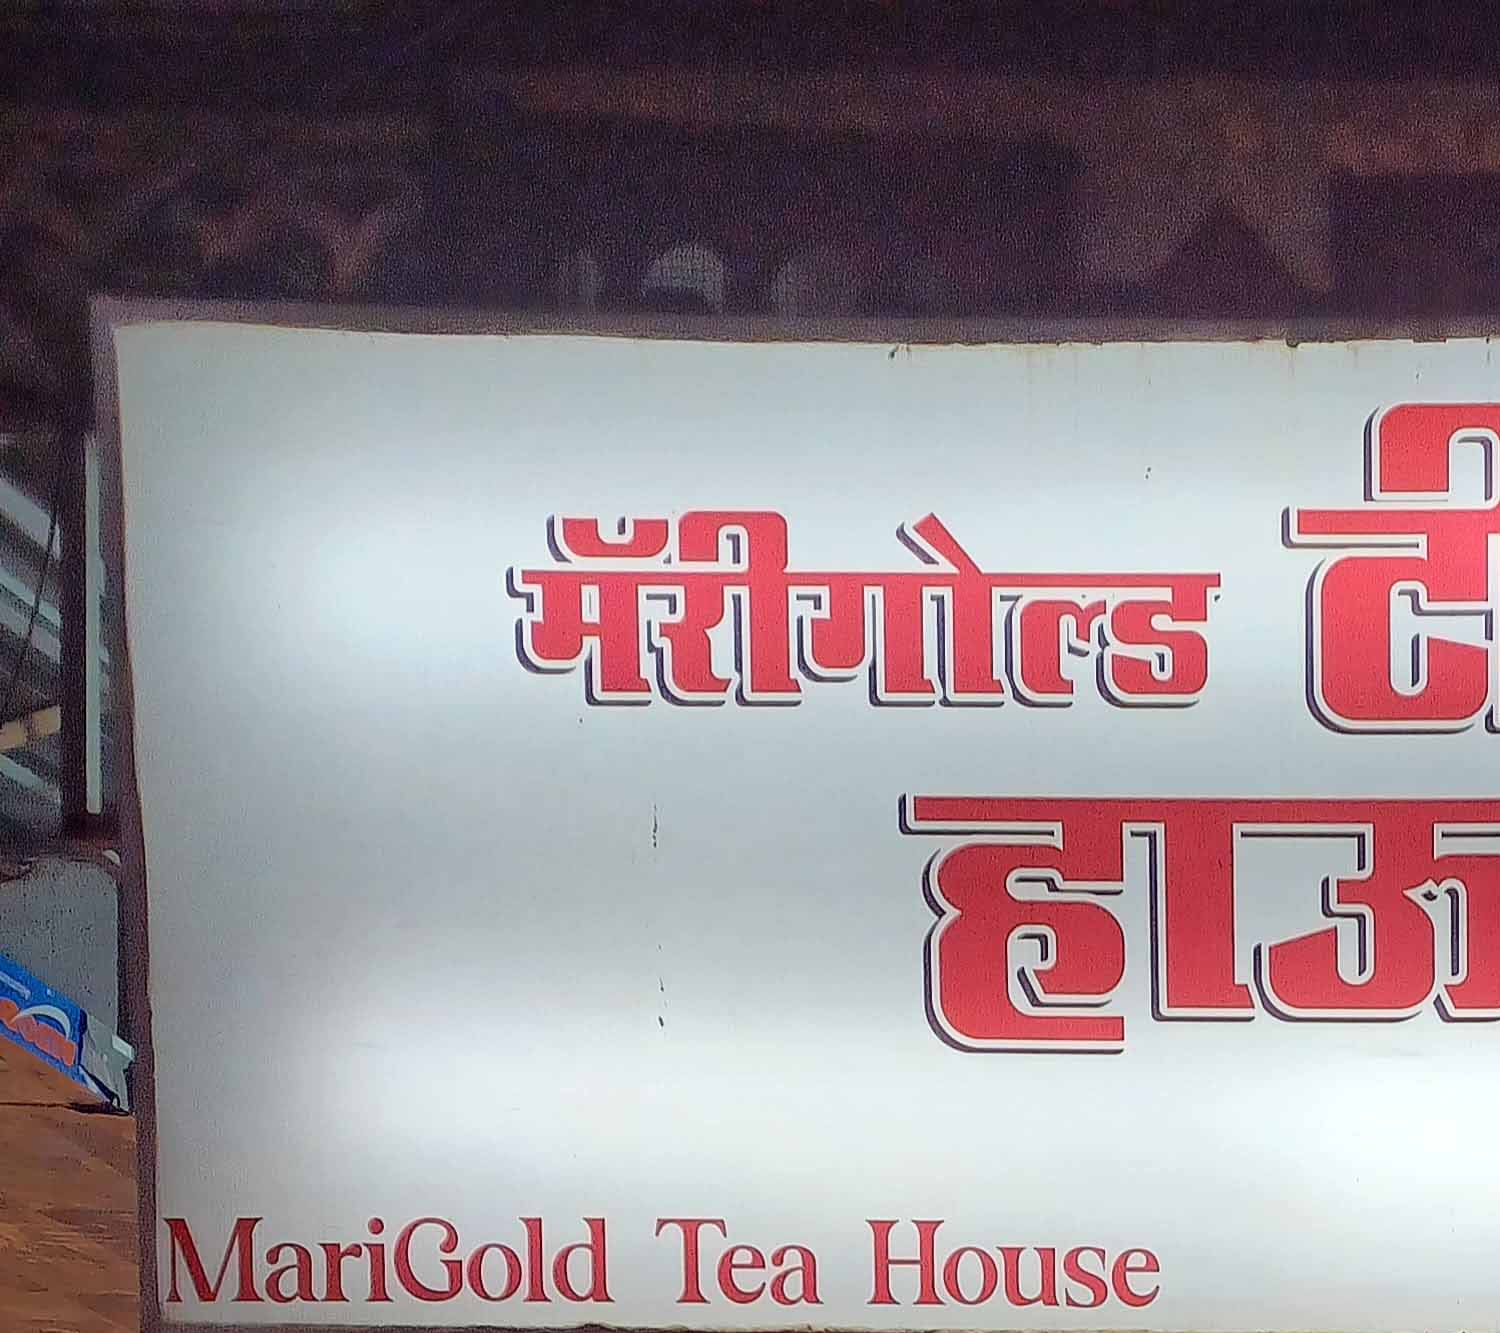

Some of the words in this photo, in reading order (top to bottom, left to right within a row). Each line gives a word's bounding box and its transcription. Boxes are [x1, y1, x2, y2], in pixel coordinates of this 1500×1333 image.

[163, 1216, 614, 1306] MariGold
[655, 1217, 822, 1307] Tea
[865, 1218, 1162, 1309] House
